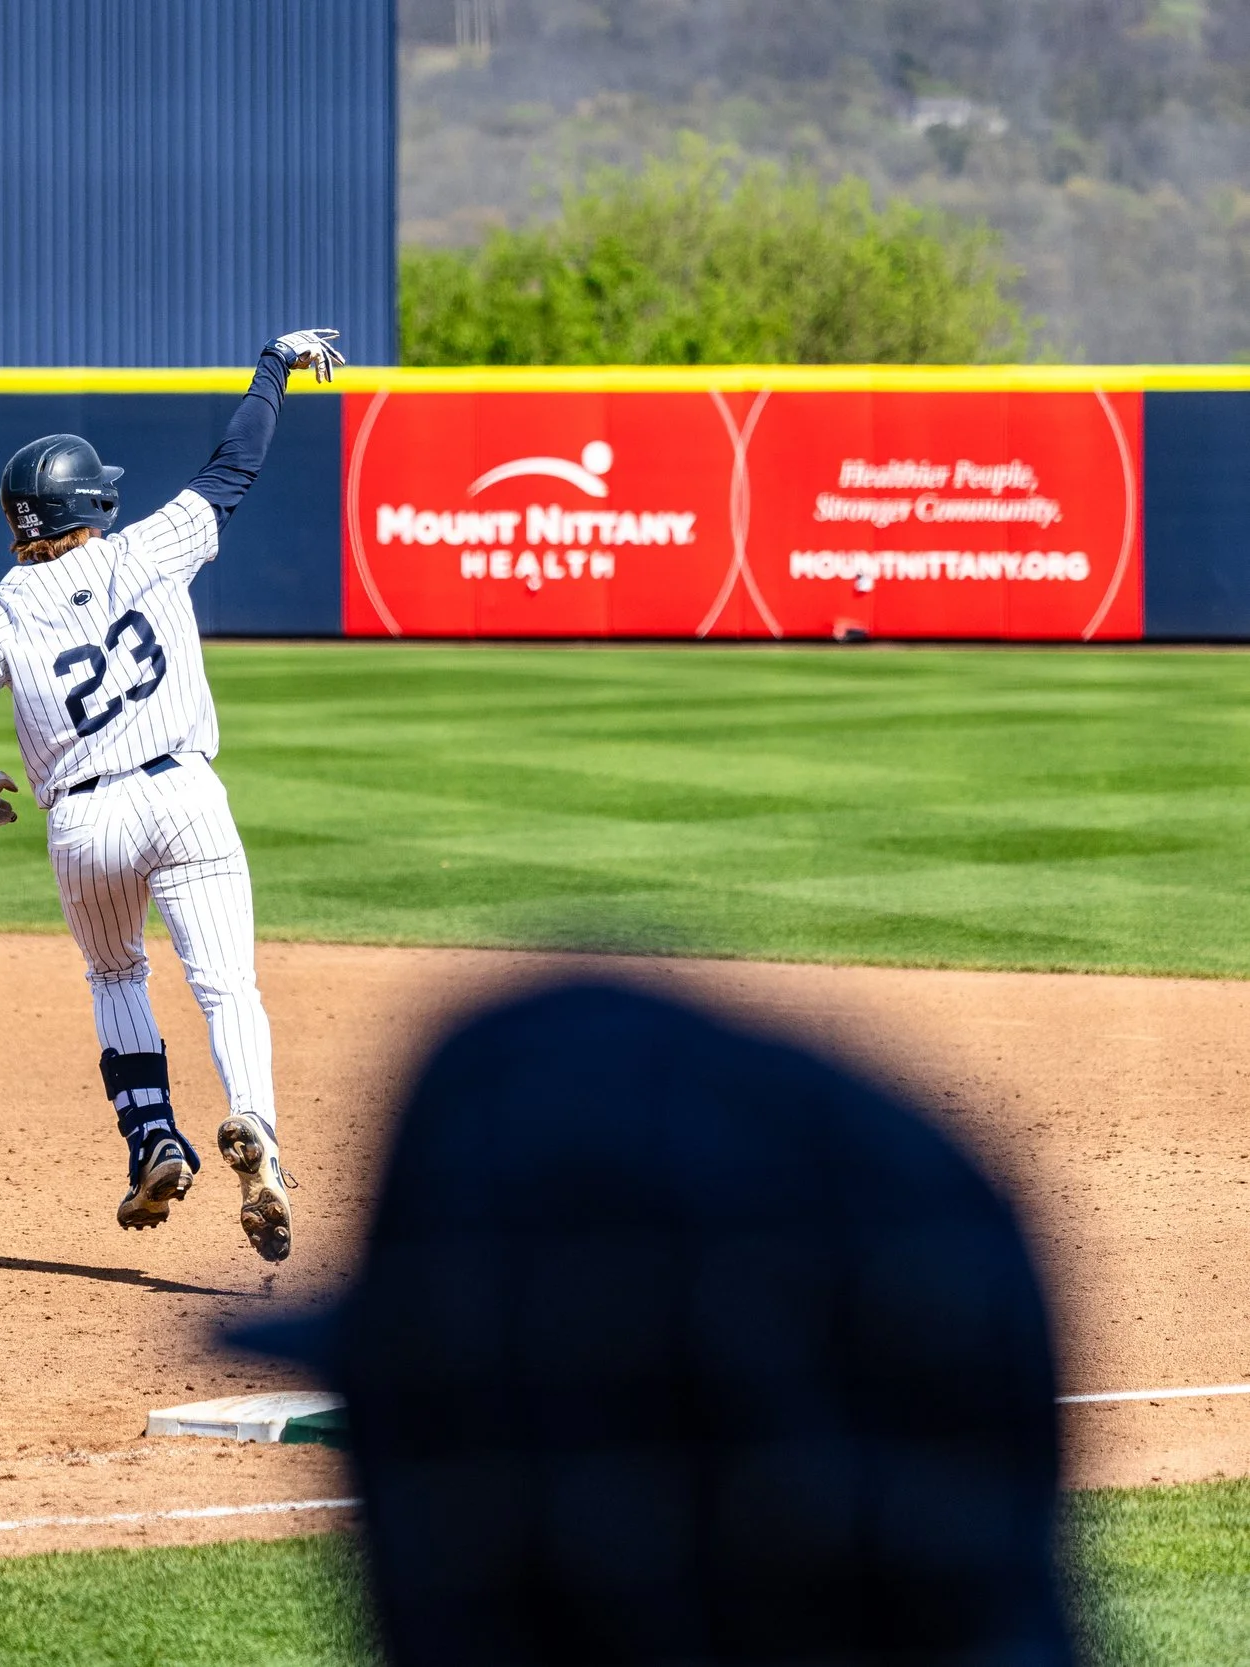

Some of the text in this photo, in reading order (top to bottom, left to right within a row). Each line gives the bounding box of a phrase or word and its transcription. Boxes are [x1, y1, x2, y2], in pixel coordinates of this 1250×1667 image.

[838, 458, 951, 488] Healthier
[16, 501, 30, 514] 23
[813, 492, 913, 528] Stronger
[460, 550, 616, 580] HEALTH
[789, 550, 1090, 580] MOUNTNITTANY.ORG
[53, 609, 167, 738] 23
